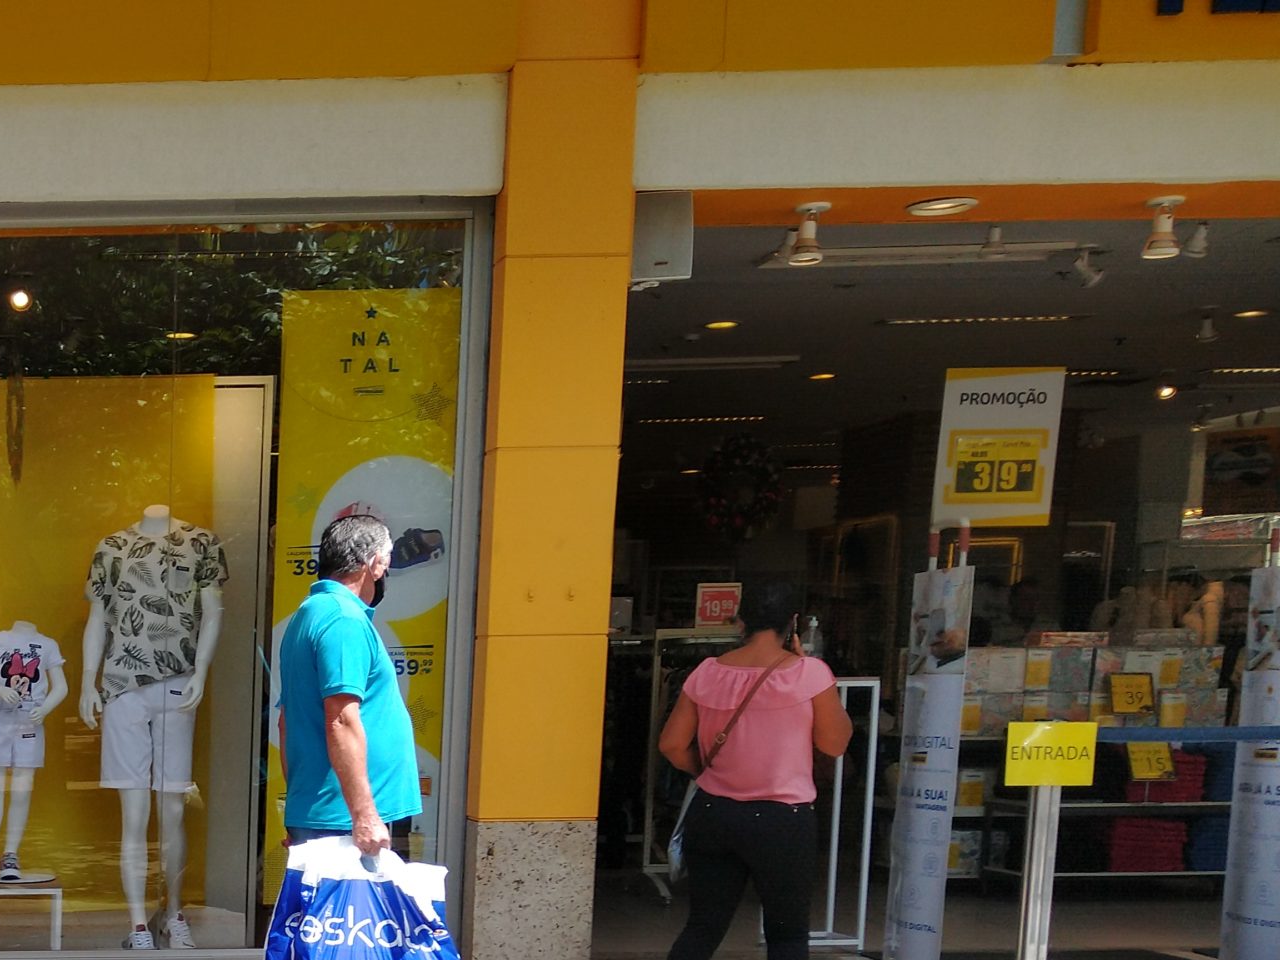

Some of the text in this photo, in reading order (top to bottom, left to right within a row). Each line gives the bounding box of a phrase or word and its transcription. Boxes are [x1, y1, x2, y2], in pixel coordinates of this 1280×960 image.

[959, 388, 1048, 408] PROMOÇÃO
[1009, 746, 1091, 761] ENTRADA
[1146, 756, 1167, 771] 15
